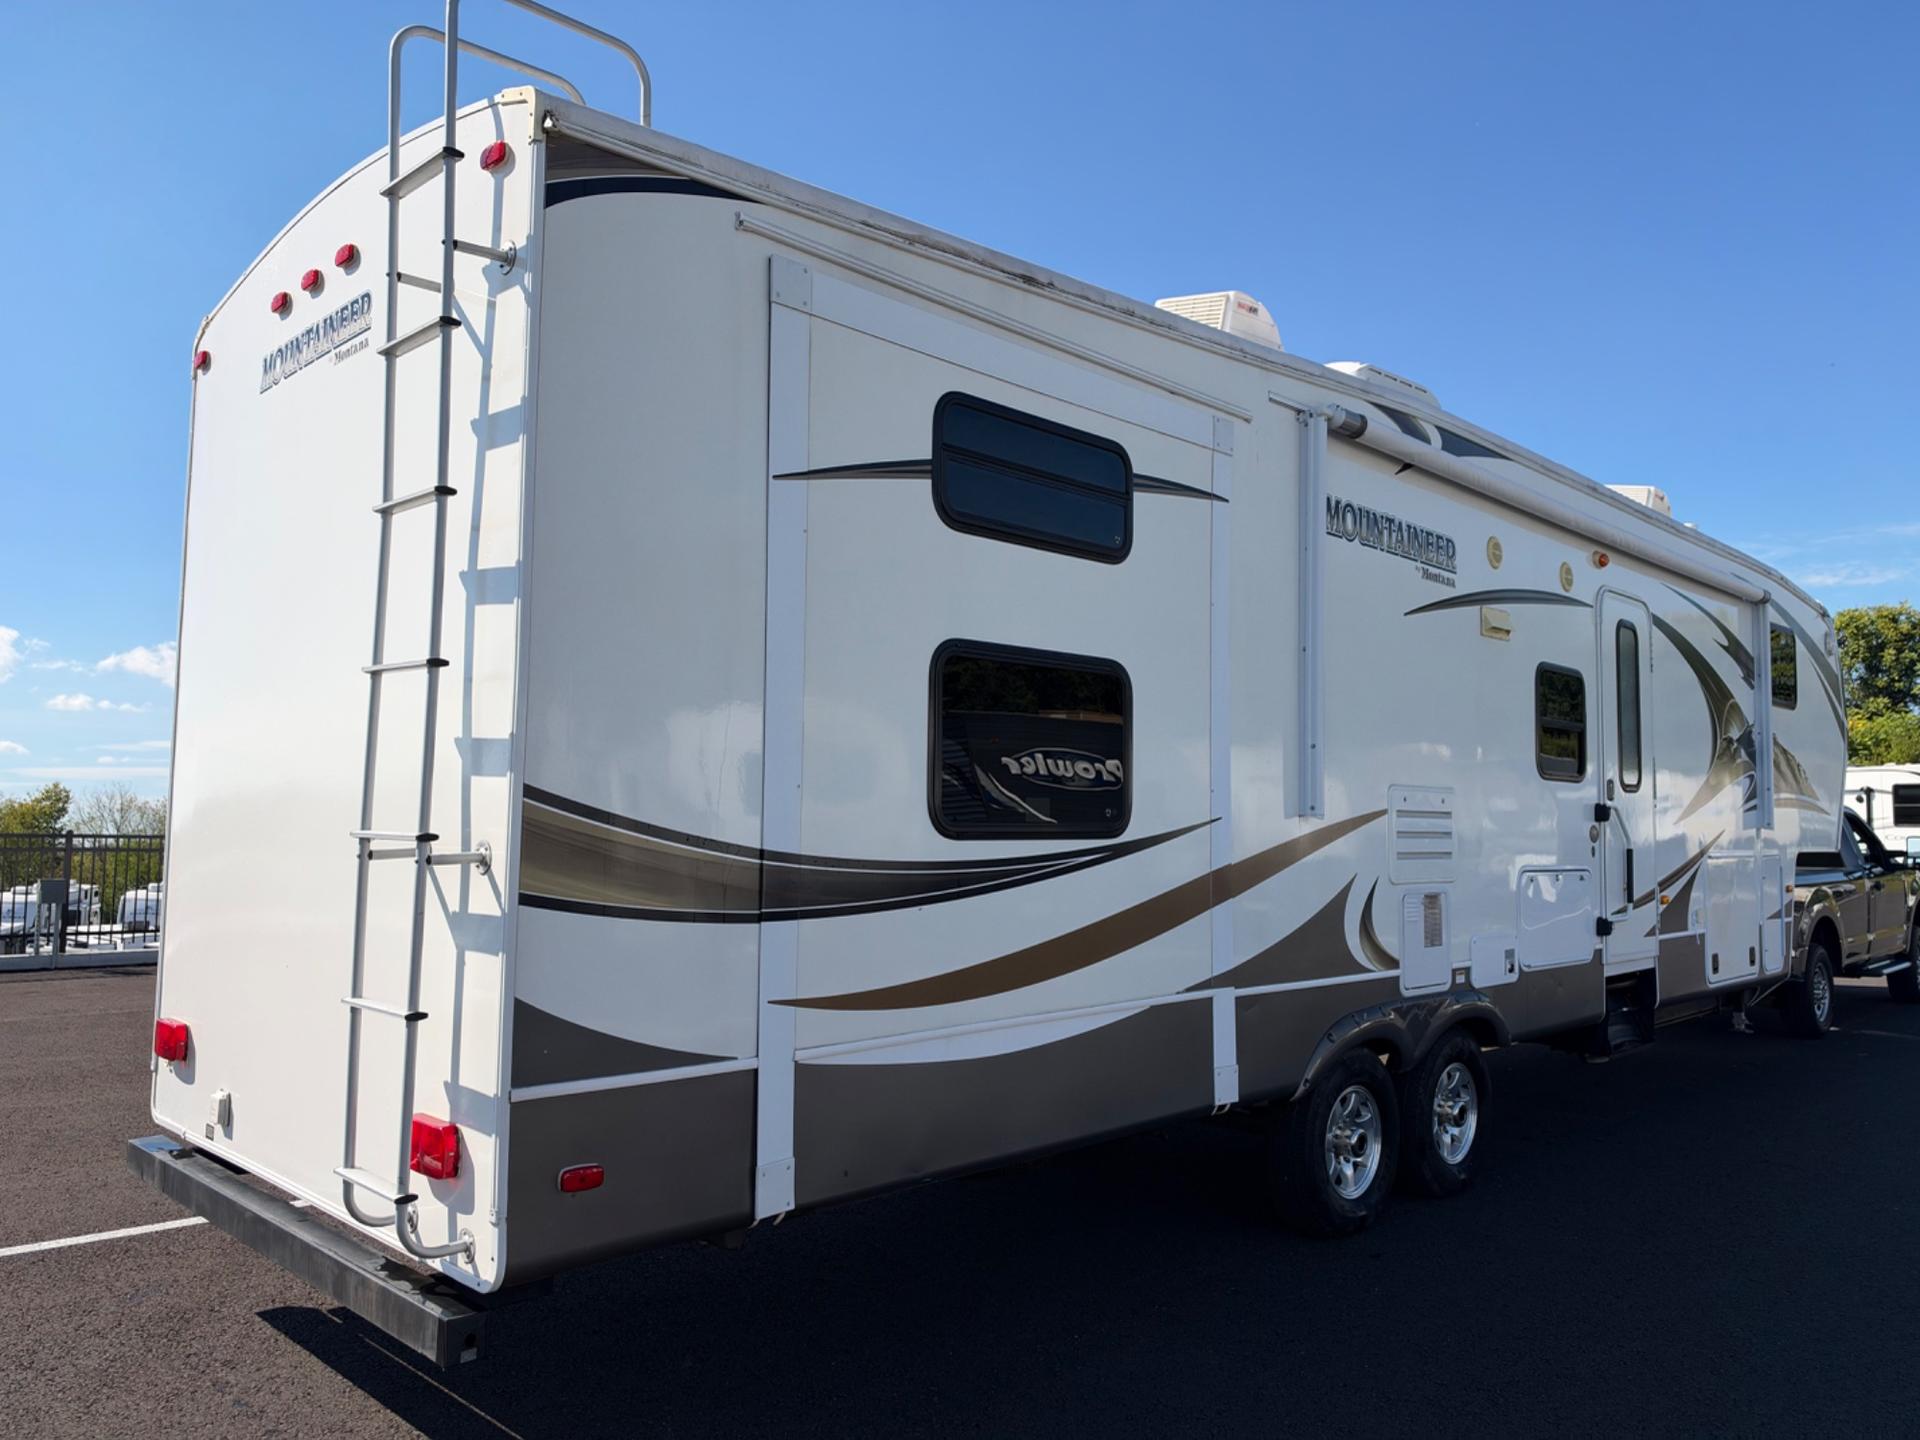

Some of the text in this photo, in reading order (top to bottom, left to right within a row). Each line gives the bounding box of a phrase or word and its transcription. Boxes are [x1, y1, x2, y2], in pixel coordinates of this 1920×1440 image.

[260, 291, 372, 391] MOUNTAINEER
[334, 337, 369, 366] Montana
[1326, 495, 1457, 572] MOUNTAINEER
[1421, 566, 1456, 589] Montana
